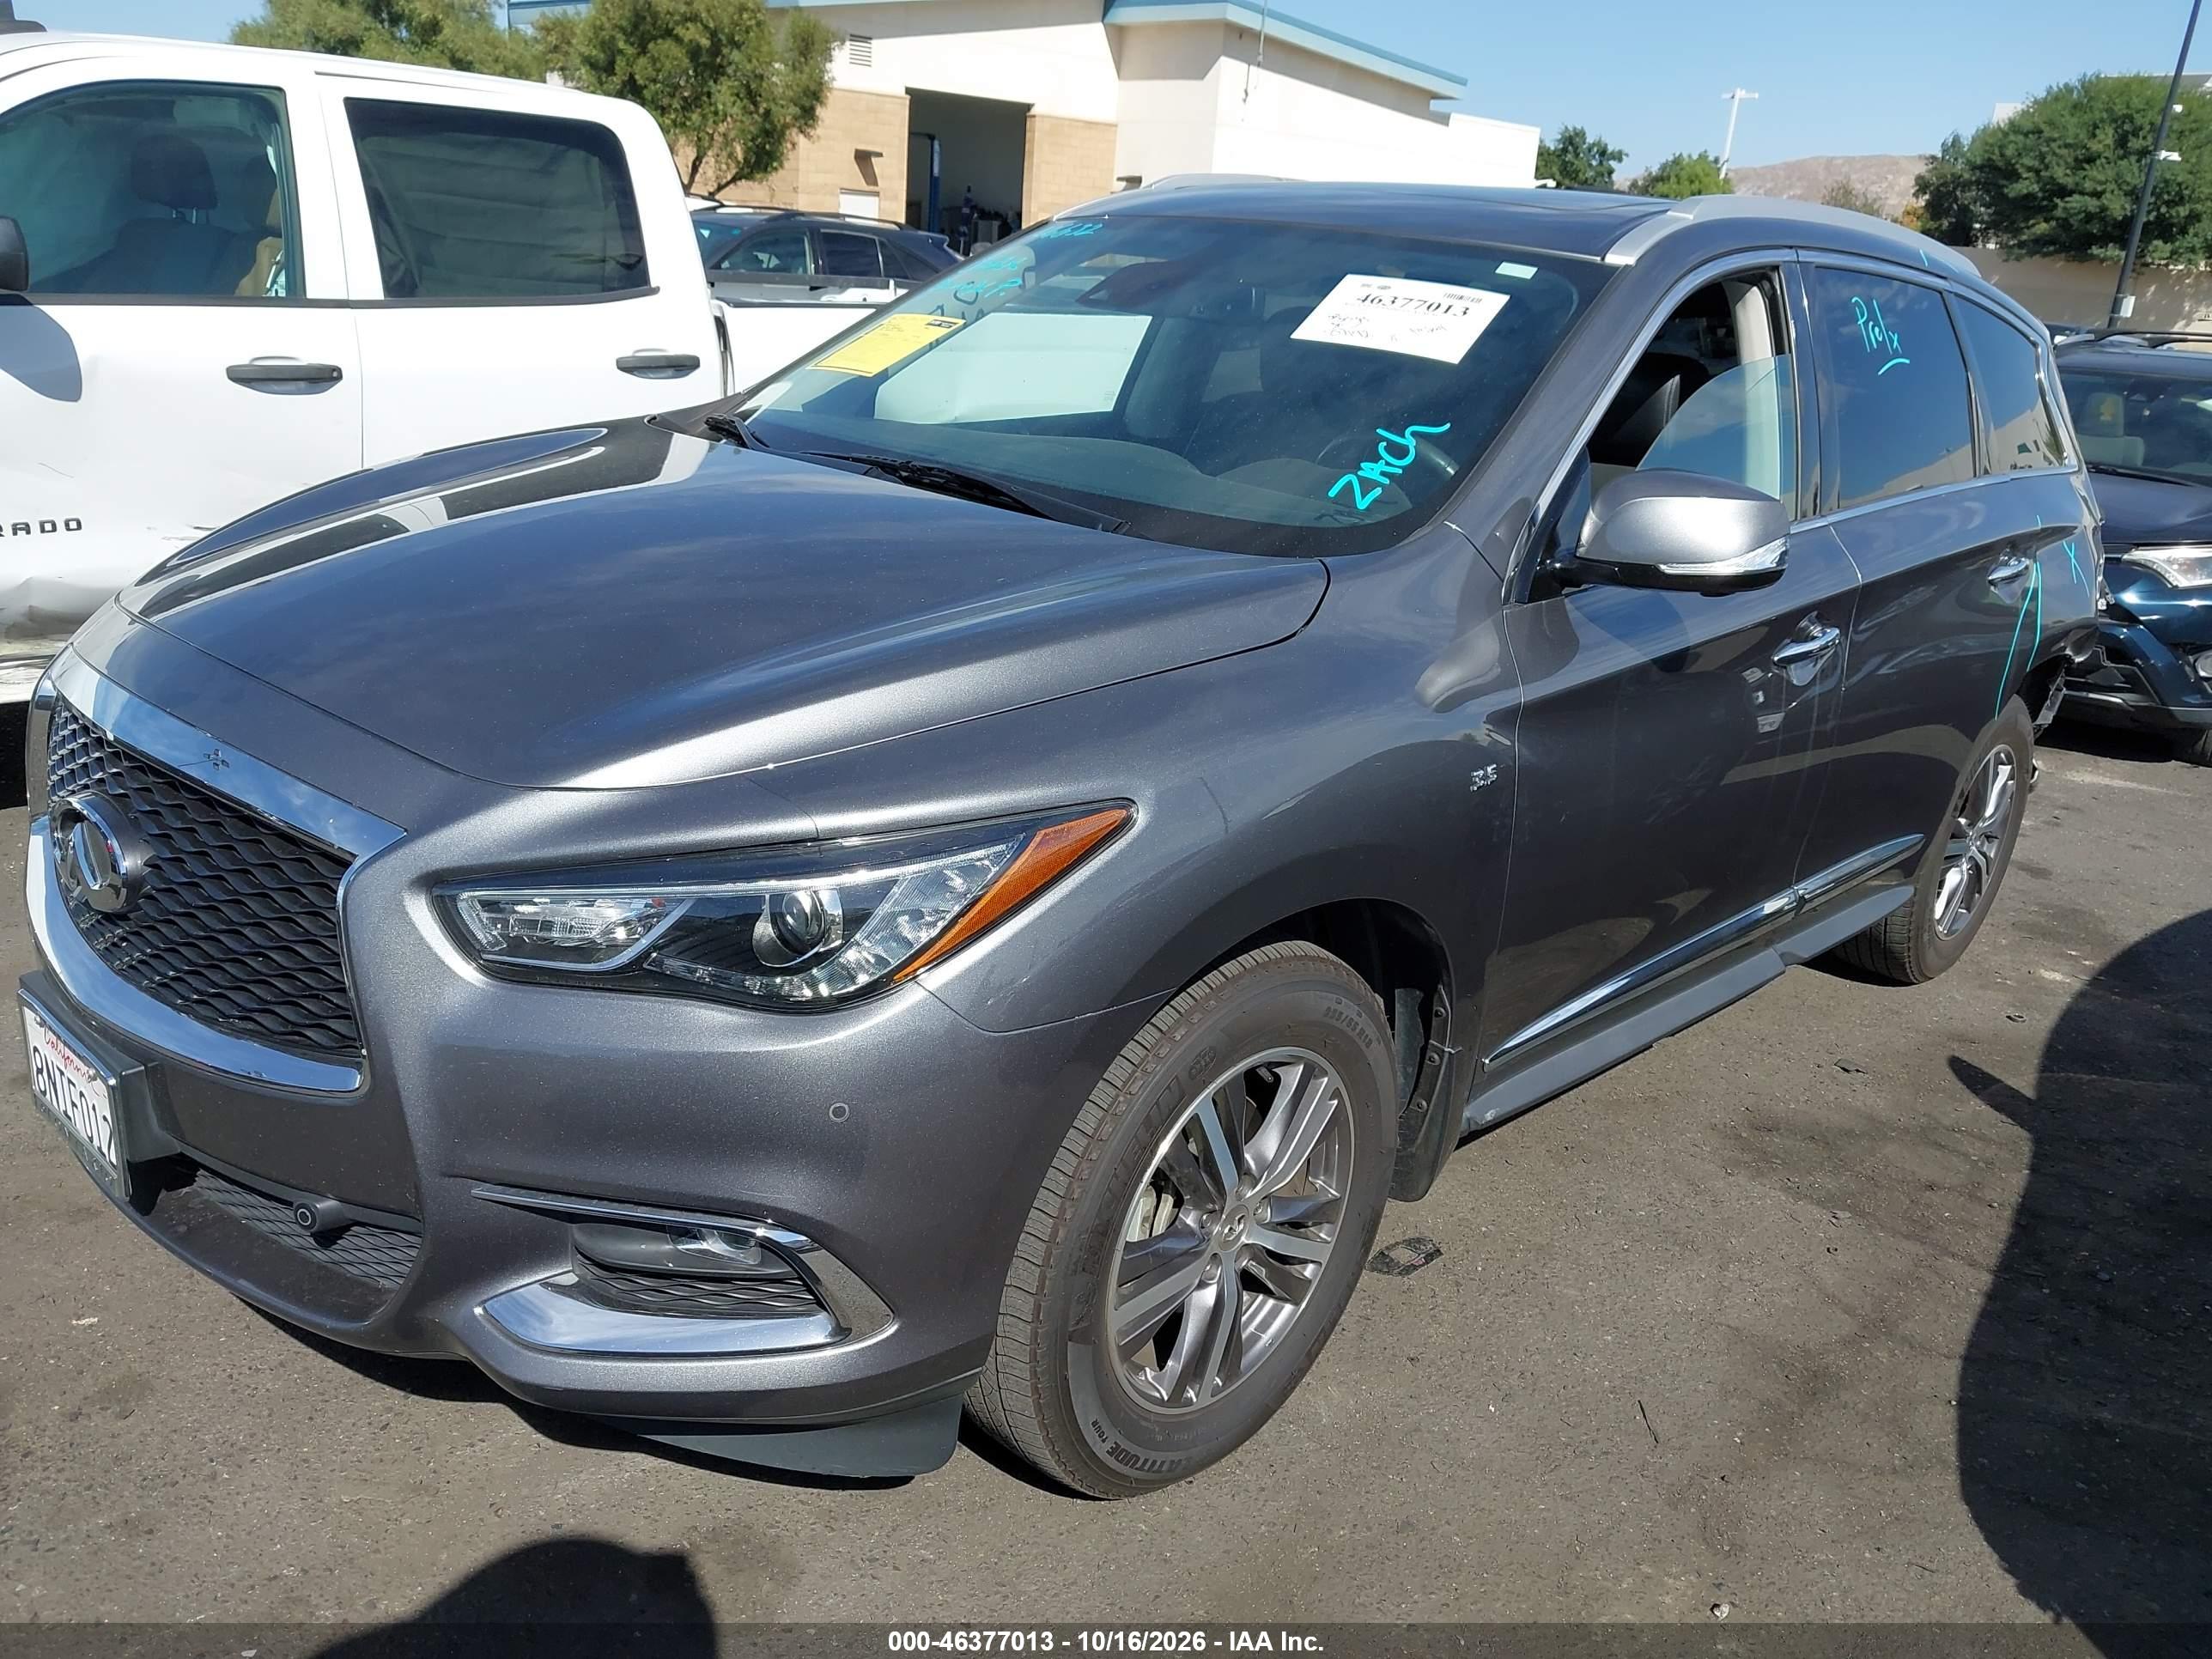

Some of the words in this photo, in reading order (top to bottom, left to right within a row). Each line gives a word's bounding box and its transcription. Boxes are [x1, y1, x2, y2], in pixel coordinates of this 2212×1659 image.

[1356, 293, 1470, 318] 46377013
[0, 517, 82, 538] ADO
[1469, 763, 1498, 793] 3.5
[1091, 1418, 1109, 1444] TOUR
